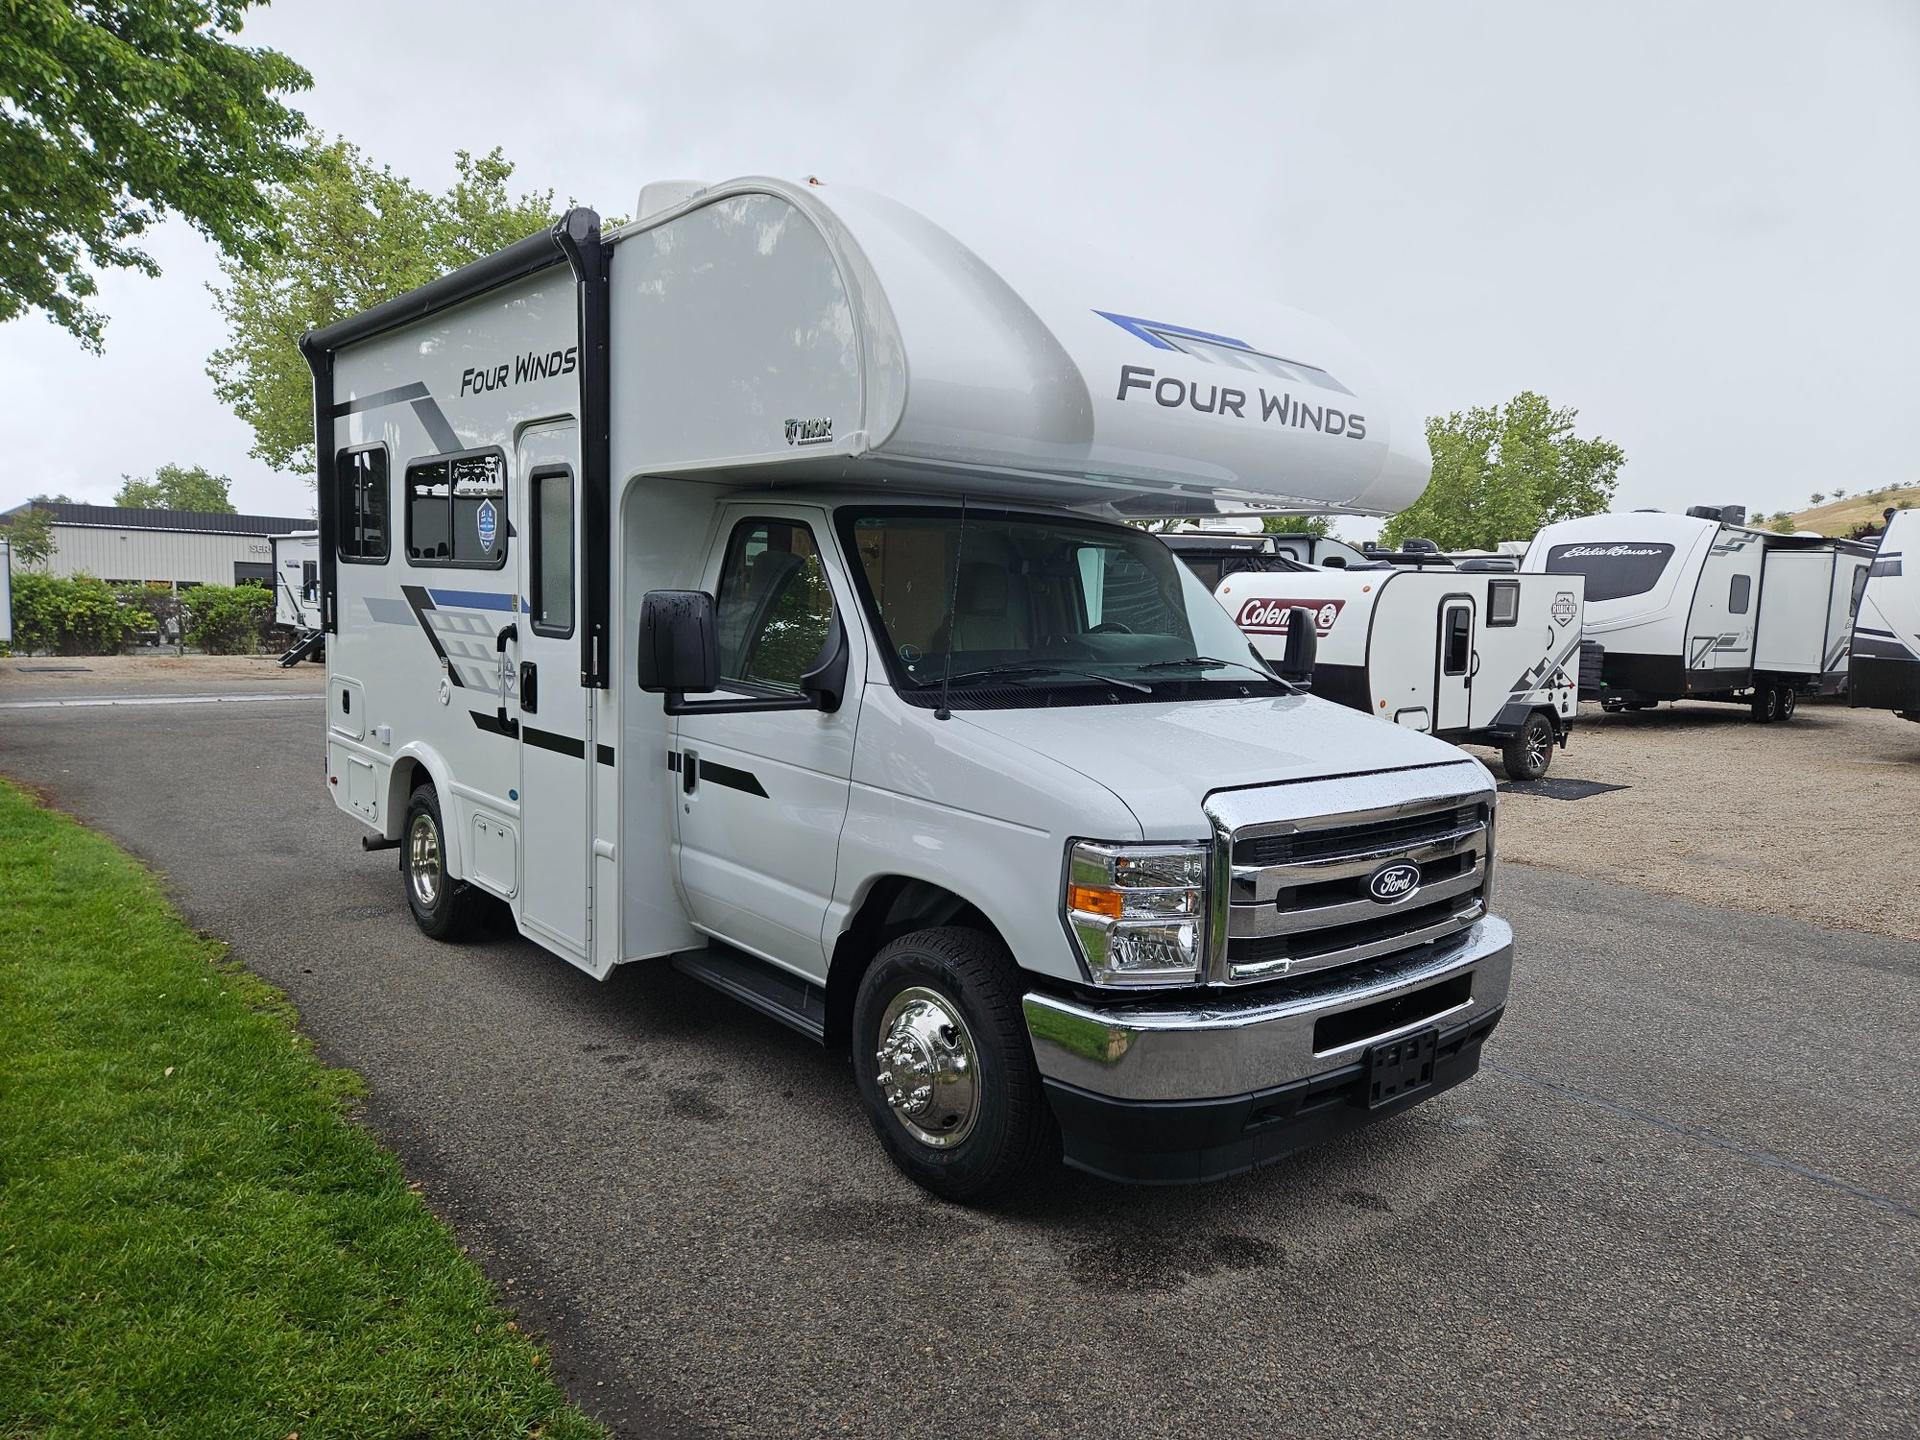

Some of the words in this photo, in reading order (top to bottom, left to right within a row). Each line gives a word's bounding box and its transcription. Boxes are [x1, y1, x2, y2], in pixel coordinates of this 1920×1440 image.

[461, 364, 509, 397] FOUR
[515, 346, 577, 385] WINDS
[1116, 364, 1246, 418] FOUR
[1259, 387, 1367, 440] WINDS
[798, 417, 833, 439] THOR
[249, 544, 272, 553] SER
[1557, 546, 1609, 559] Eddie
[1607, 545, 1663, 556] Bauer
[1241, 599, 1318, 625] Colem
[1552, 604, 1576, 614] RUBICON
[1380, 869, 1412, 894] Ford
